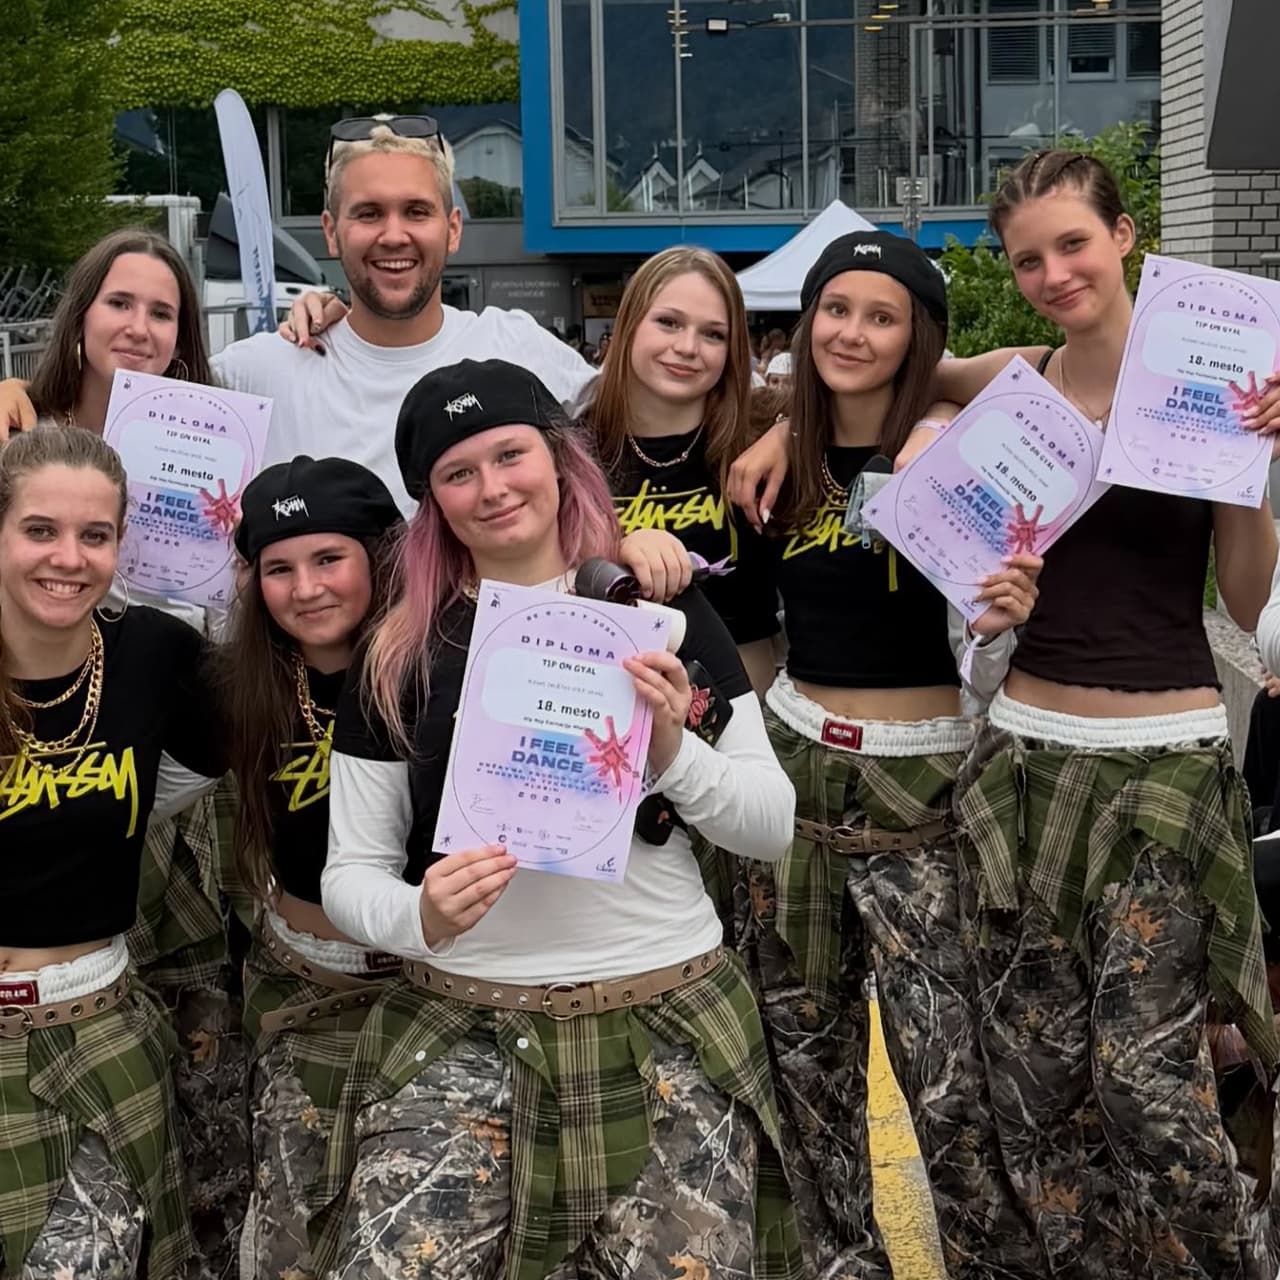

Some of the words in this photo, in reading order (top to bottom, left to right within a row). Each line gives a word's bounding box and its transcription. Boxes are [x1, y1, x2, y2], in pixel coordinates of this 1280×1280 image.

[1177, 301, 1258, 323] DIPLOMA
[1188, 354, 1205, 366] 18.
[1209, 359, 1244, 374] mesto
[1180, 387, 1225, 405] FEEL
[1165, 398, 1228, 419] DANCE
[148, 410, 227, 433] DIPLOMA
[1015, 410, 1076, 468] DIPLOMA
[161, 462, 177, 474] 18.
[180, 467, 214, 481] mesto
[994, 460, 1009, 478] 18.
[1009, 474, 1038, 502] mesto
[154, 493, 197, 511] FEEL
[953, 485, 1003, 531] DANCE
[972, 485, 1005, 519] FEEL
[139, 503, 200, 524] DANCE
[521, 635, 615, 659] DIPLOMA
[537, 699, 556, 713] 18.
[560, 704, 600, 720] mesto
[529, 738, 580, 757] FEEL
[511, 750, 585, 773] DANCE
